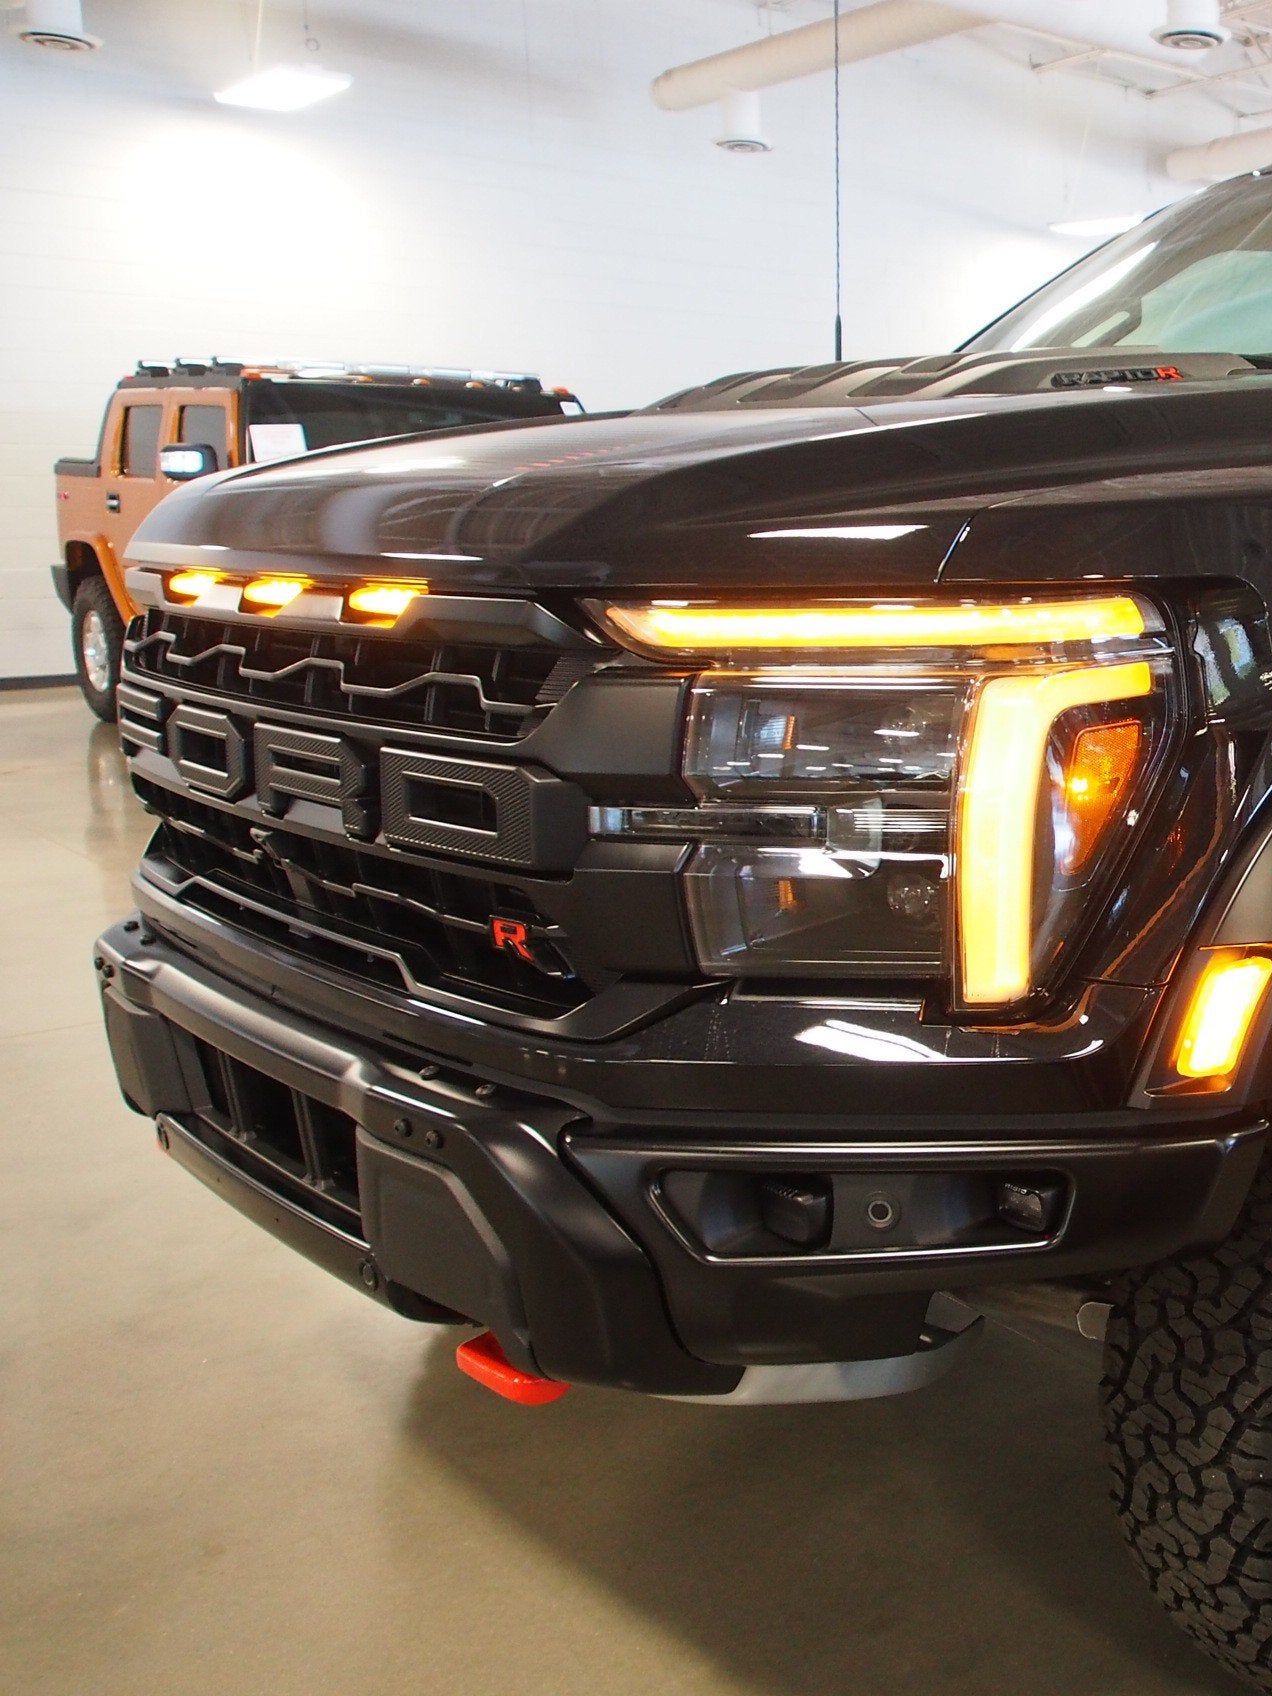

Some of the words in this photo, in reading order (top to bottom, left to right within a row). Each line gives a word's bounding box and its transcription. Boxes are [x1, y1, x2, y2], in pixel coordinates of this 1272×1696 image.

[1053, 366, 1184, 386] RAPTOR
[117, 682, 550, 867] FORD
[491, 916, 534, 962] R
